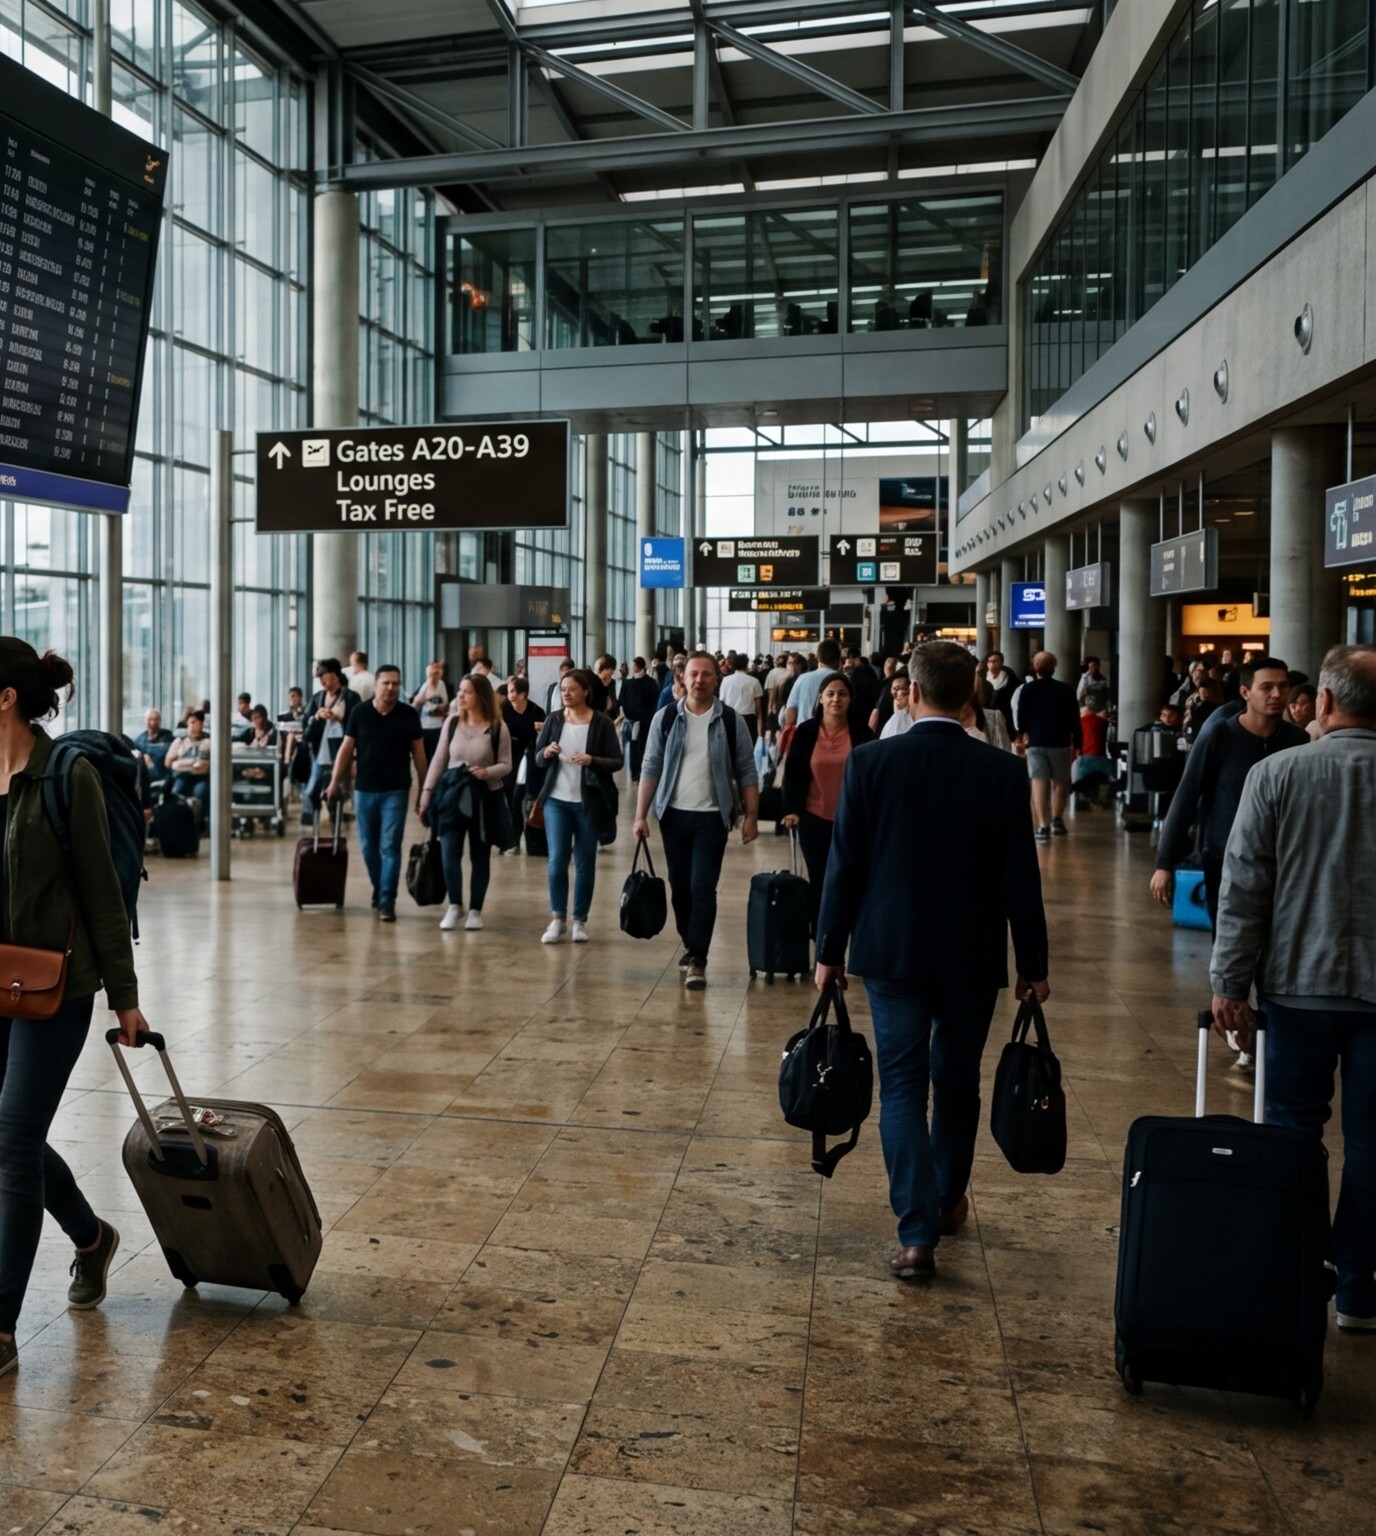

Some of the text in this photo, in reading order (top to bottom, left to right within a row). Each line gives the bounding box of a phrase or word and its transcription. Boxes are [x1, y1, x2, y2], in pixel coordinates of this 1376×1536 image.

[336, 434, 530, 463] Gates A20-A39
[337, 470, 436, 497] Lounges
[336, 499, 435, 522] Tax Free
